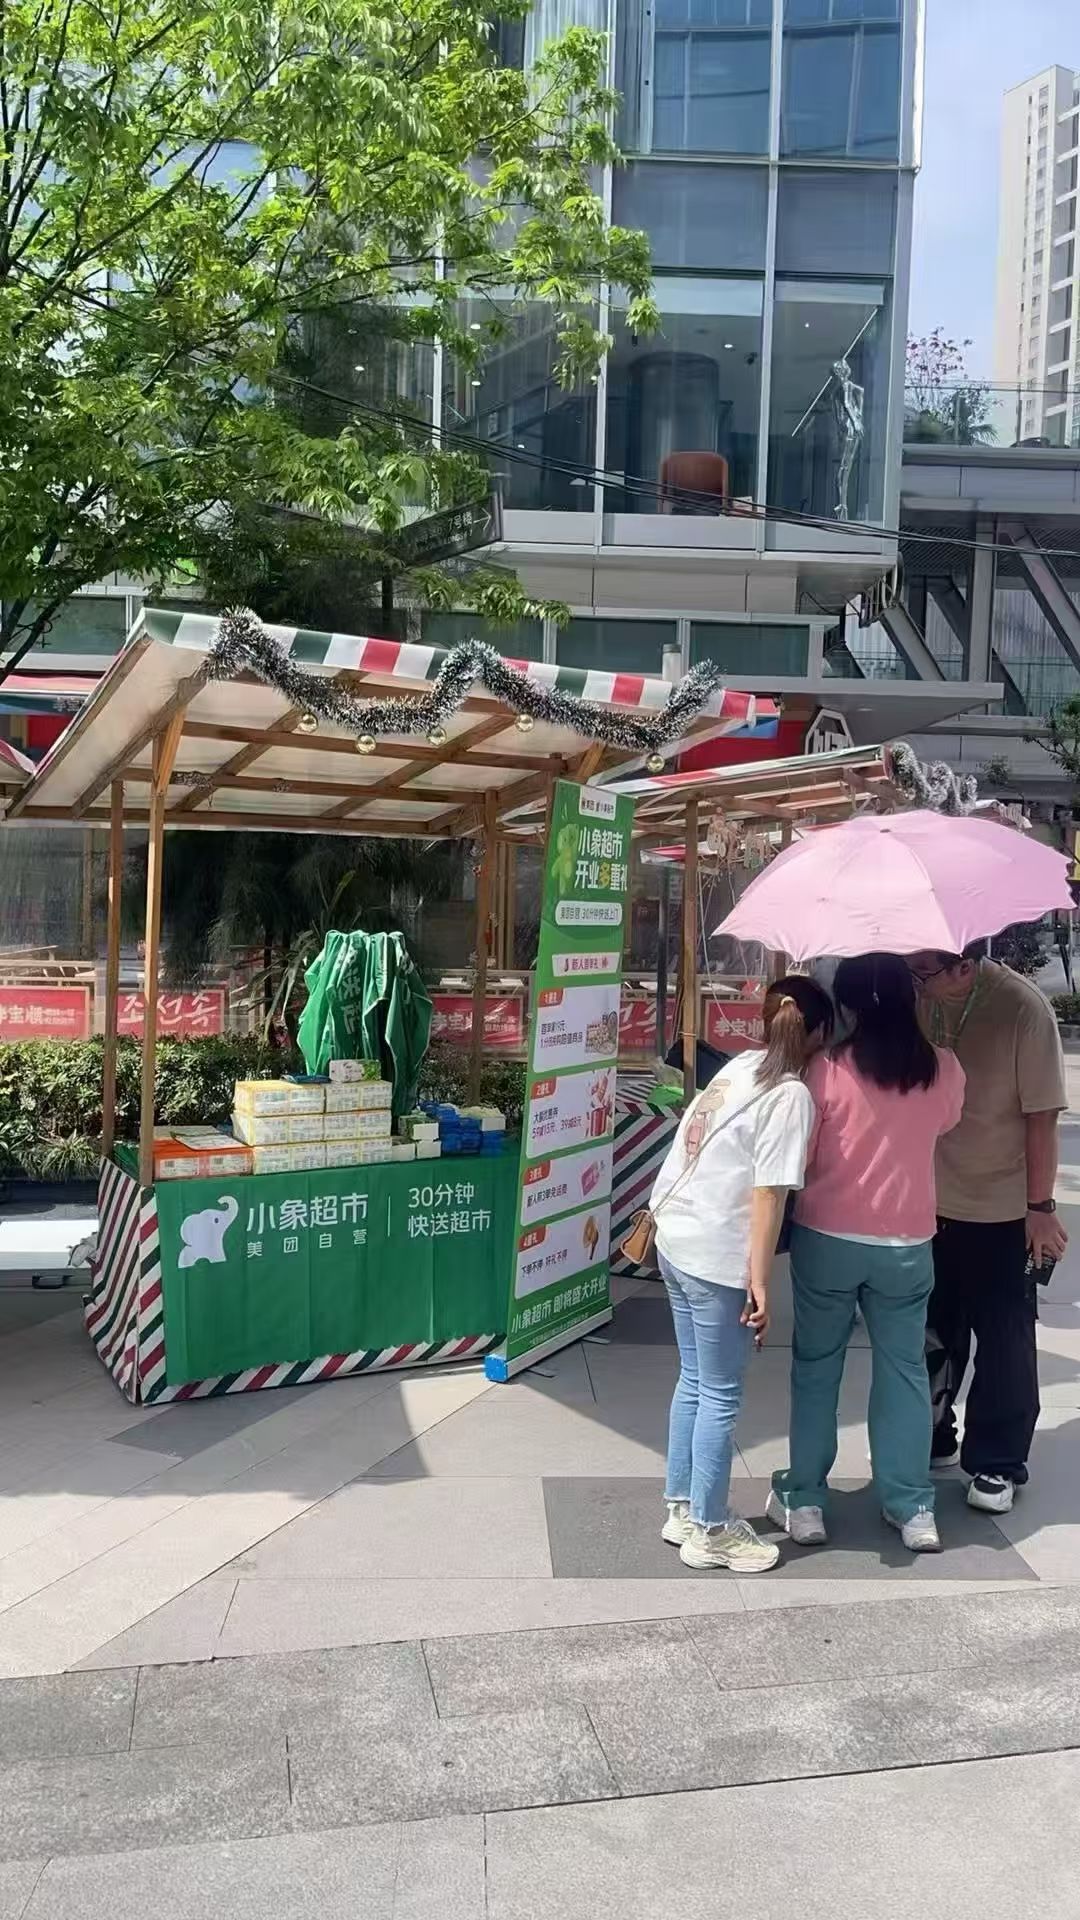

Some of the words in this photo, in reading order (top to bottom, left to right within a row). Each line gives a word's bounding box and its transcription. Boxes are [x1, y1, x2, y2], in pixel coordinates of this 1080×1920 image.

[578, 826, 624, 860] 小象超市
[574, 860, 628, 892] 开业多重礼
[408, 1182, 475, 1208] 30分钟
[246, 1192, 369, 1235] 小象超市
[407, 1209, 492, 1238] 快送超市
[511, 1299, 553, 1334] 小象超市
[553, 1274, 607, 1313] 即将盛大开业
